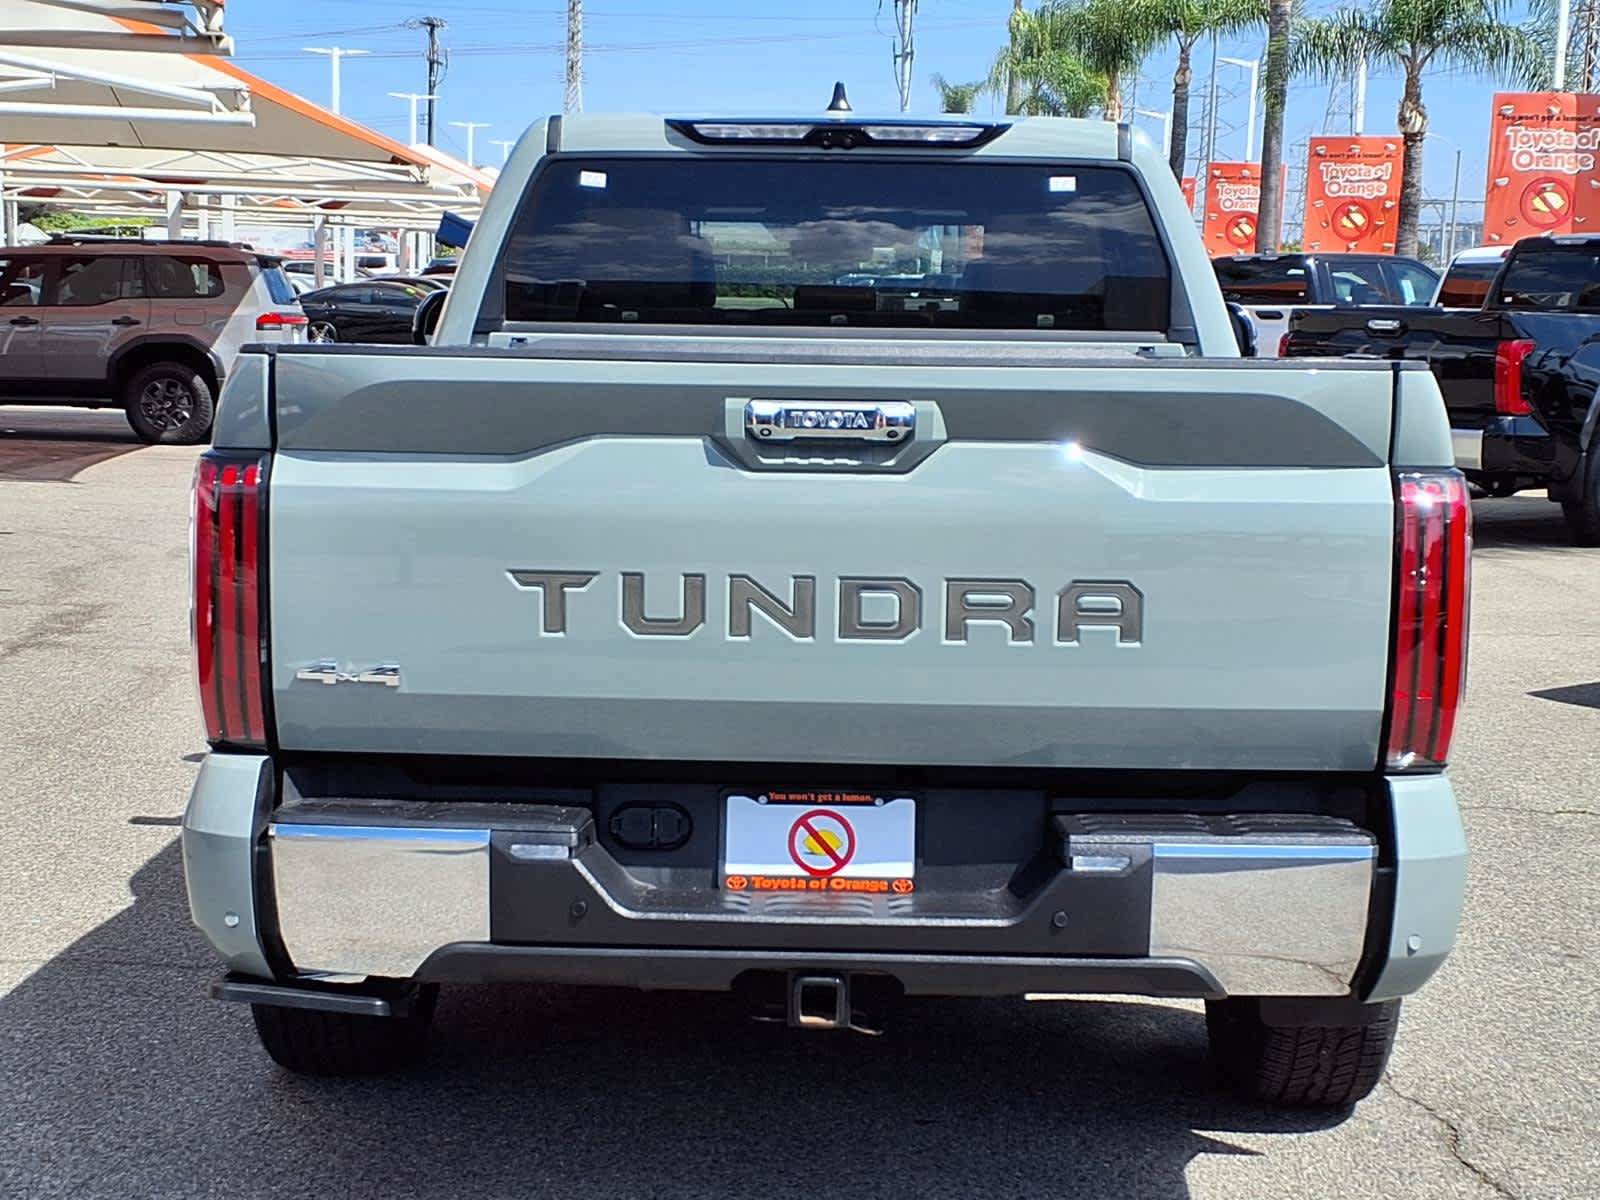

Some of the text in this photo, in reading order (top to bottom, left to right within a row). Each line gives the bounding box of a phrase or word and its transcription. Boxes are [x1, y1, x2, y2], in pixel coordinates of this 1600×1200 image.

[1507, 127, 1600, 150] Toyota of
[1513, 149, 1594, 174] Orange
[1321, 162, 1392, 182] Toyota of
[1217, 183, 1260, 199] Toyota
[1326, 181, 1387, 198] Orange
[790, 410, 868, 429] TOYOTA
[505, 569, 1146, 649] TUNDRA
[768, 792, 786, 801] You
[788, 792, 815, 801] won't
[751, 876, 889, 893] Toyota of Orange
